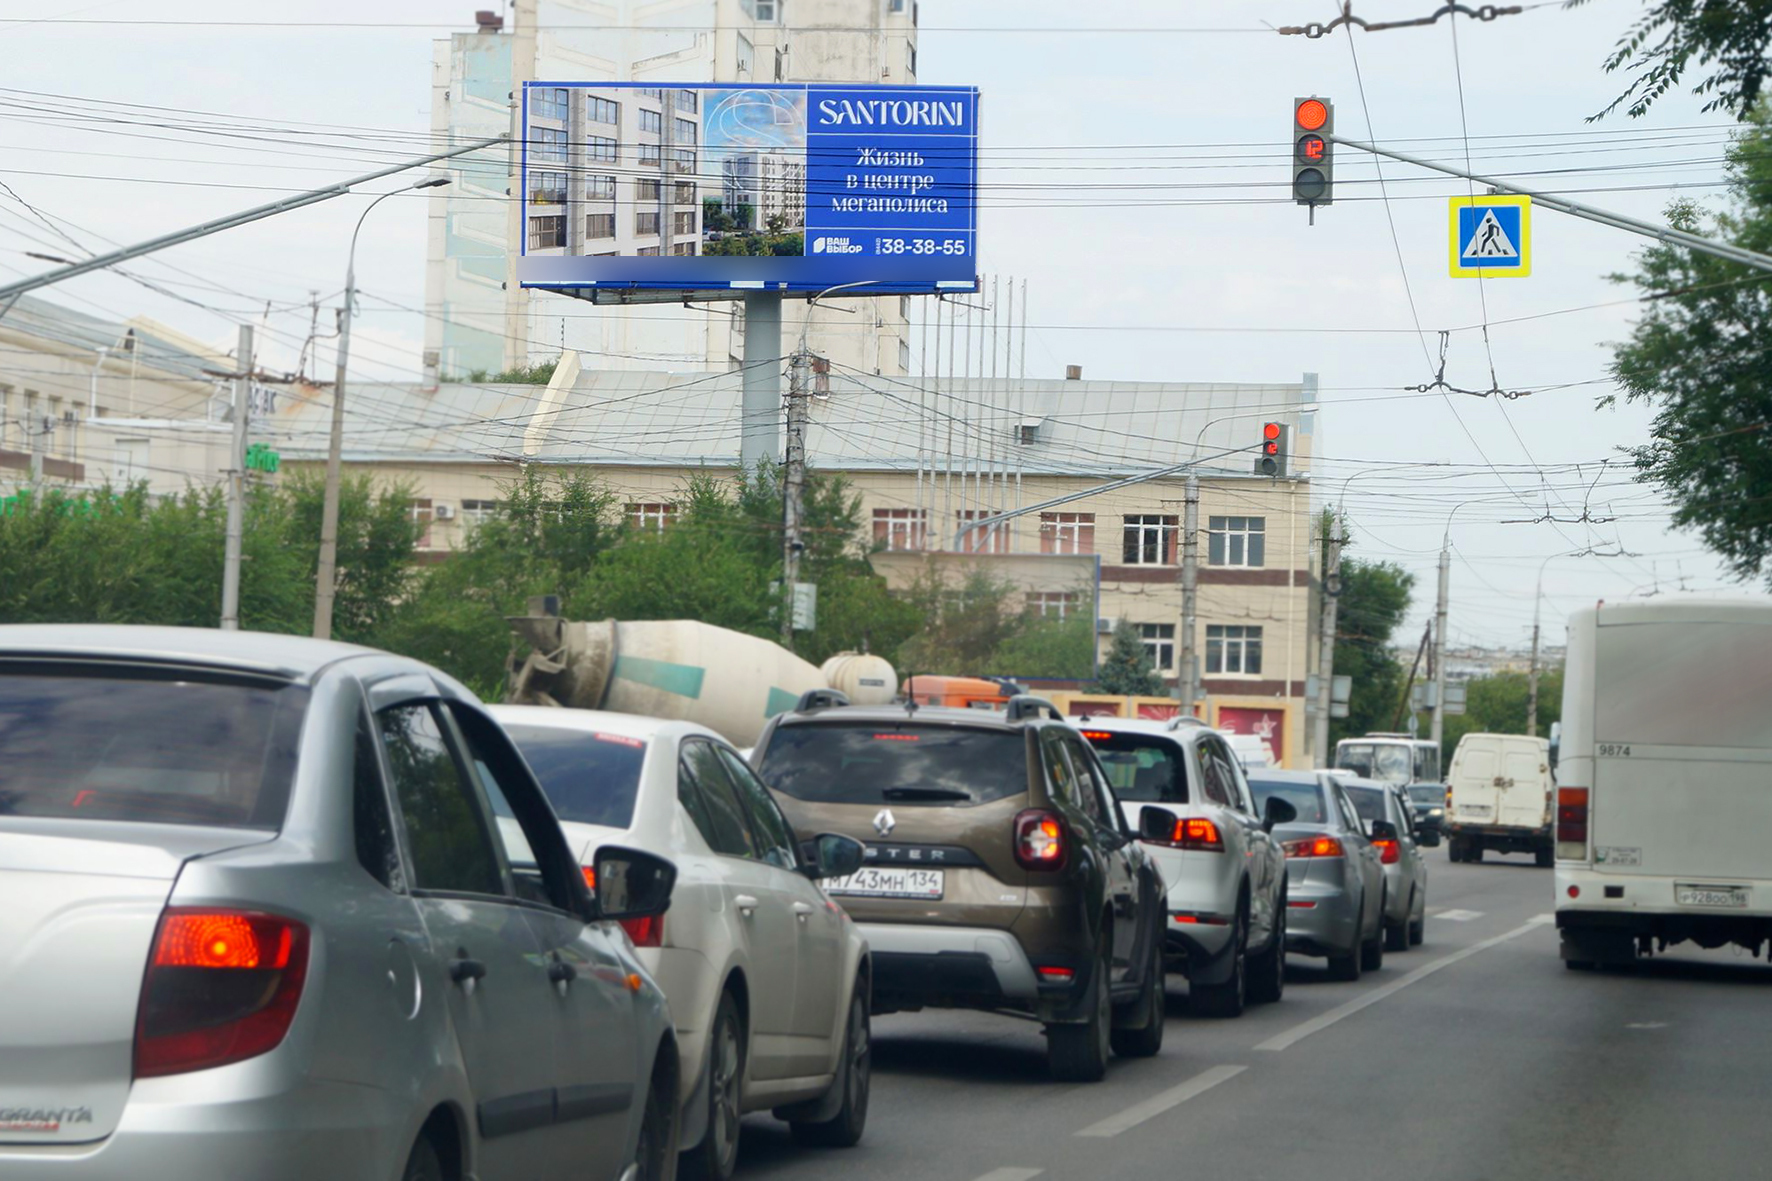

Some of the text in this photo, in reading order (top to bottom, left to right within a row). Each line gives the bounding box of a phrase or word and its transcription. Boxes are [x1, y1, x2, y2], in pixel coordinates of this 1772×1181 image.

[819, 99, 963, 126] SANTORINI
[856, 147, 924, 166] Жизнь
[846, 174, 934, 195] в центре
[832, 197, 948, 213] мегаполиса
[826, 237, 850, 246] ВАШ
[826, 245, 863, 254] ВЫБОР
[882, 238, 965, 255] 38-38-55
[1599, 744, 1631, 757] 9874
[864, 848, 944, 859] STER
[909, 871, 938, 887] 134
